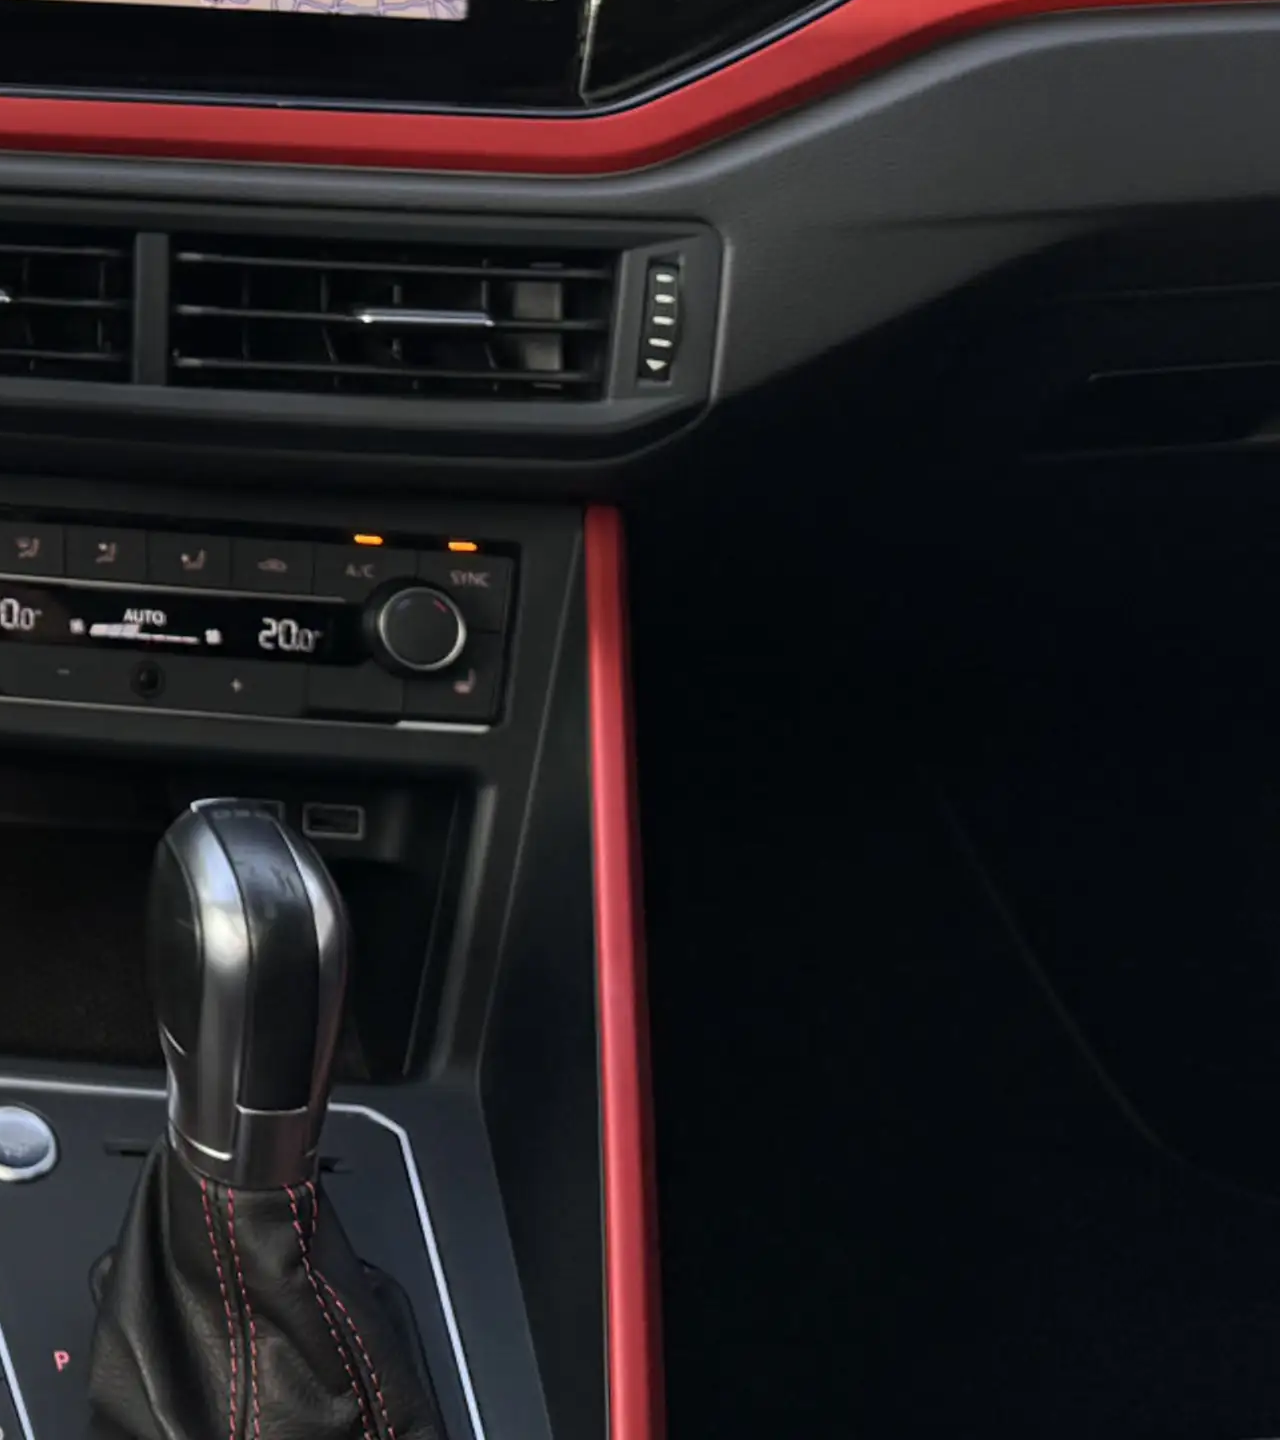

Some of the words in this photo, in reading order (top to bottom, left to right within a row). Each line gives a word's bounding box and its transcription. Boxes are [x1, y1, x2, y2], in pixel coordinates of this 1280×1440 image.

[345, 564, 375, 579] A/C
[449, 570, 491, 588] SYNC
[123, 608, 168, 626] AUTO
[54, 1350, 70, 1372] P
